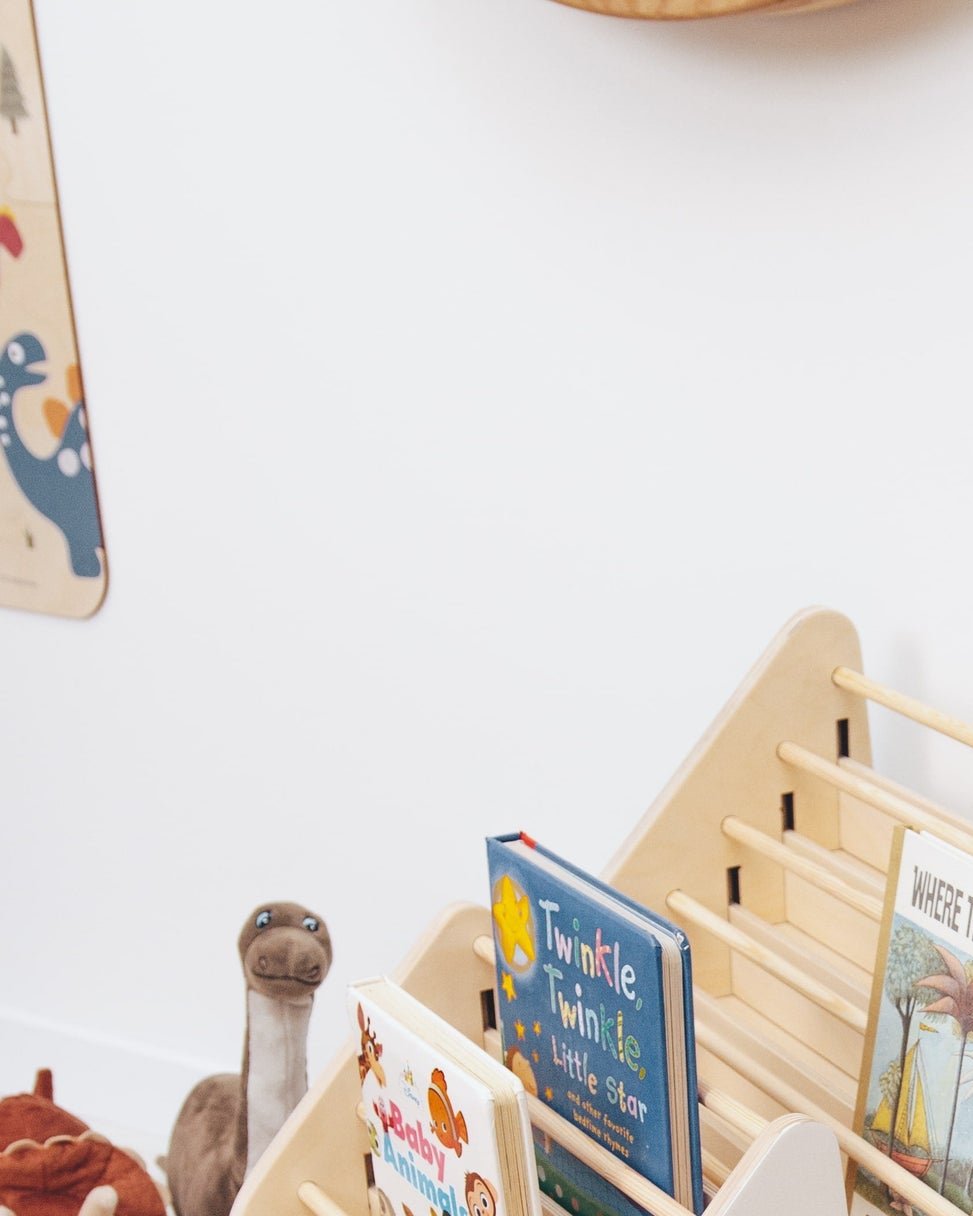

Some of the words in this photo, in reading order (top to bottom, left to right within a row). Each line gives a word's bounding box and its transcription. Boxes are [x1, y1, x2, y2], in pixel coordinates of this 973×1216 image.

[911, 865, 964, 932] WHERE
[538, 898, 642, 1010] Twinkle,
[543, 963, 647, 1080] Twinkle,
[551, 1035, 598, 1095] Little
[389, 1099, 445, 1184] Baby
[567, 1090, 580, 1106] and
[581, 1101, 601, 1120] other
[603, 1113, 634, 1144] favorite
[573, 1108, 601, 1138] bedtime
[603, 1132, 629, 1158] rhymes
